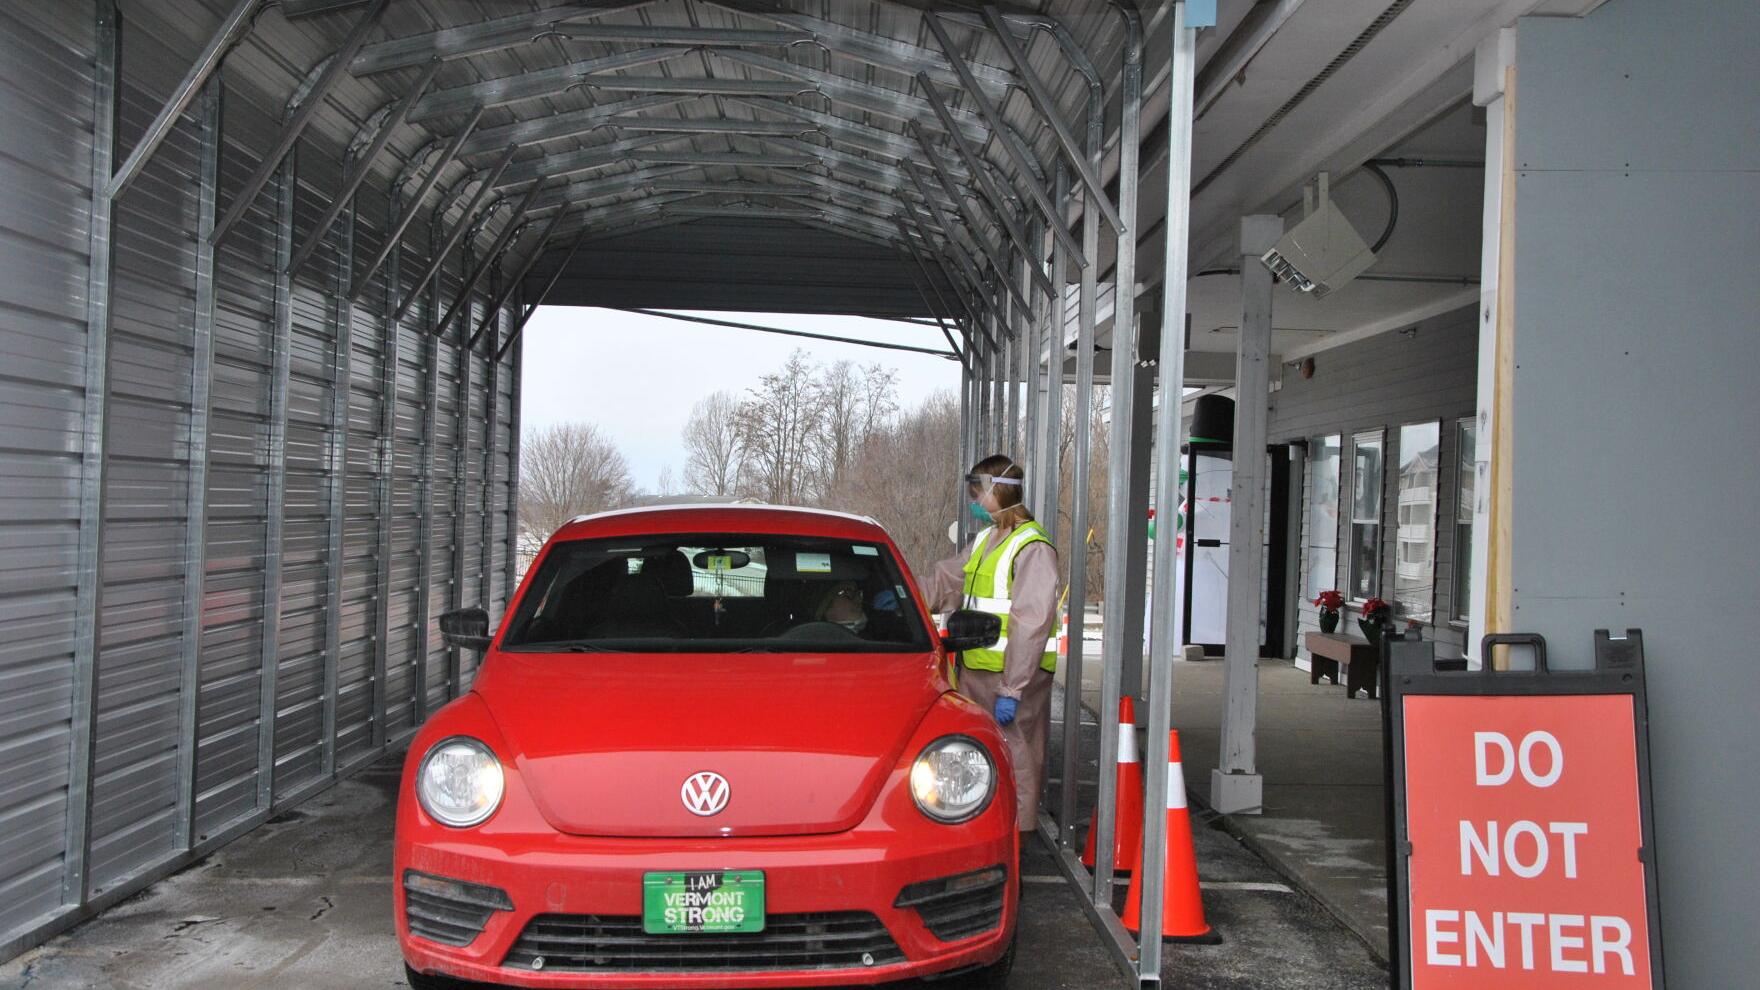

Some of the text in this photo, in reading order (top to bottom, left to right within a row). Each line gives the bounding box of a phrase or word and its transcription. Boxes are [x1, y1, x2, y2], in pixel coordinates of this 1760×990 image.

[1474, 730, 1563, 788] DO
[681, 771, 731, 816] VW
[1459, 820, 1588, 879] NOT
[664, 891, 745, 907] VERMONT
[690, 874, 716, 891] I AM
[664, 907, 745, 924] STRONG
[1425, 909, 1635, 976] ENTER
